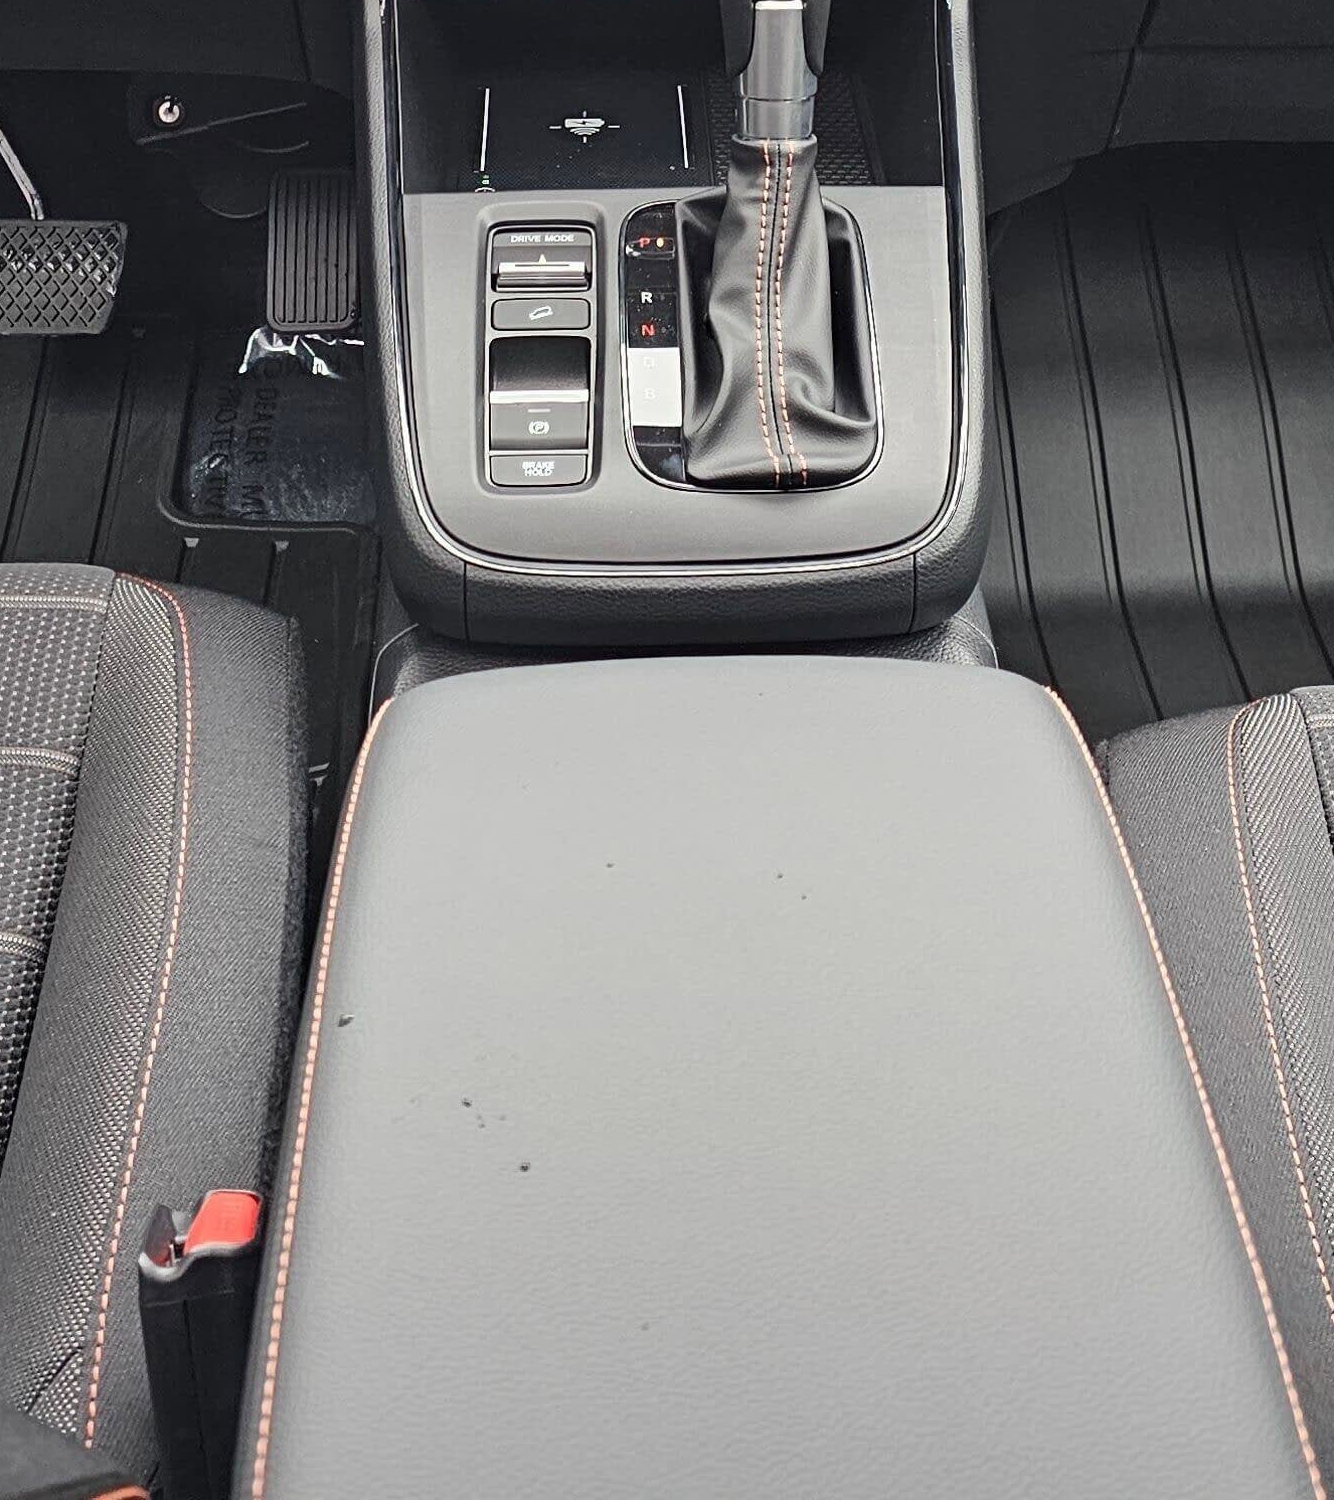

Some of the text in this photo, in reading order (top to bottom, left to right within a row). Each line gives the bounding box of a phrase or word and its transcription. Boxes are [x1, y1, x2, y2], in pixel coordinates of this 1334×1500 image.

[511, 235, 541, 243] DRIVE
[639, 237, 651, 248] P
[641, 291, 653, 304] R
[641, 325, 655, 336] N
[522, 461, 555, 469] BRAKE
[524, 468, 553, 477] HOLD
